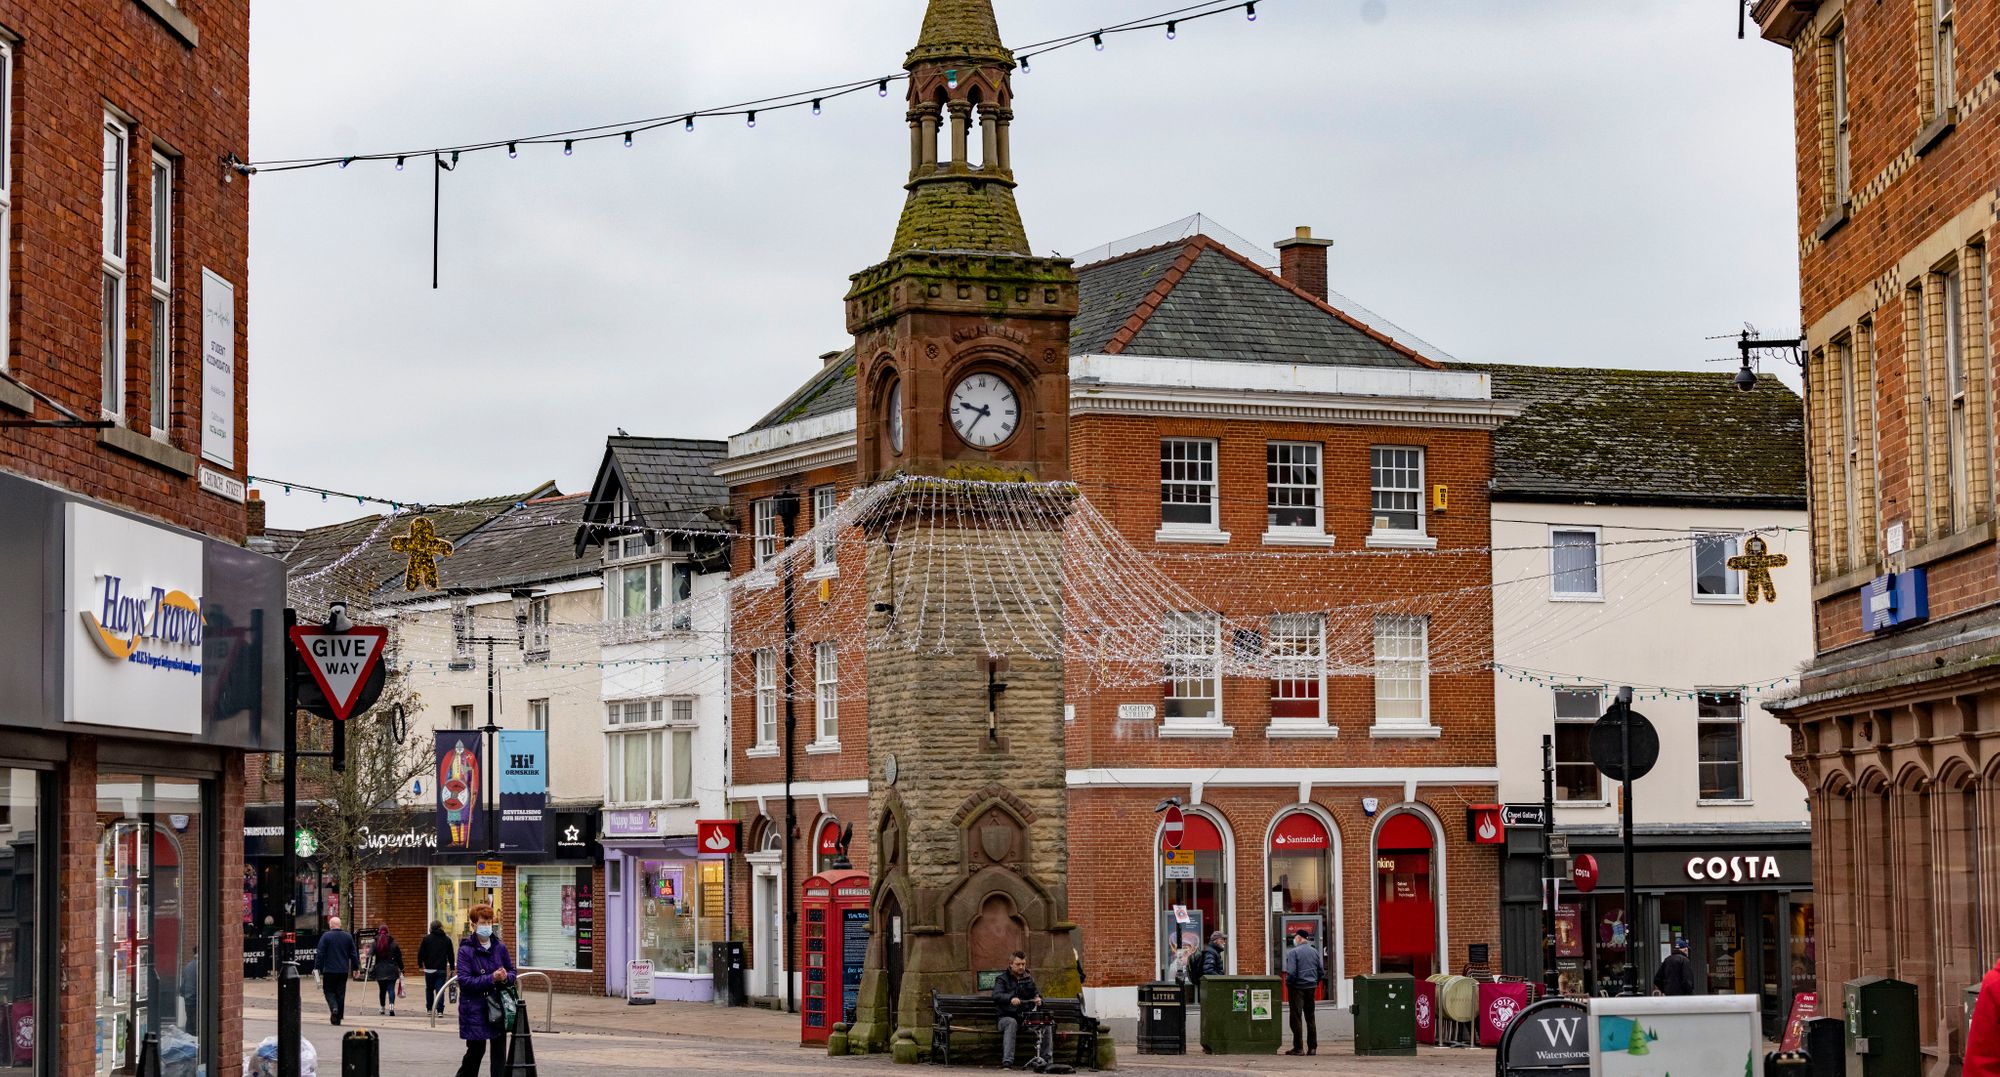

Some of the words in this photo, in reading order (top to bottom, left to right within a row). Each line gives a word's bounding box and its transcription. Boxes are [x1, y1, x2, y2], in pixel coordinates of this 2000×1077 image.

[204, 471, 224, 491] CHURCH
[226, 480, 242, 498] STREET
[101, 574, 146, 648] Hays
[150, 586, 204, 646] Travel
[312, 639, 366, 657] GIVE
[326, 662, 359, 674] WAY
[510, 754, 534, 768] Hi!
[611, 814, 628, 828] Happy
[1508, 812, 1522, 820] Chapel
[358, 826, 438, 854] Superdru
[1286, 834, 1324, 843] Santander
[1575, 868, 1590, 878] COSTA
[1688, 856, 1781, 882] COSTA
[1493, 999, 1516, 1008] COSTA
[1538, 1017, 1581, 1048] W
[1536, 1051, 1590, 1060] Waterstones
